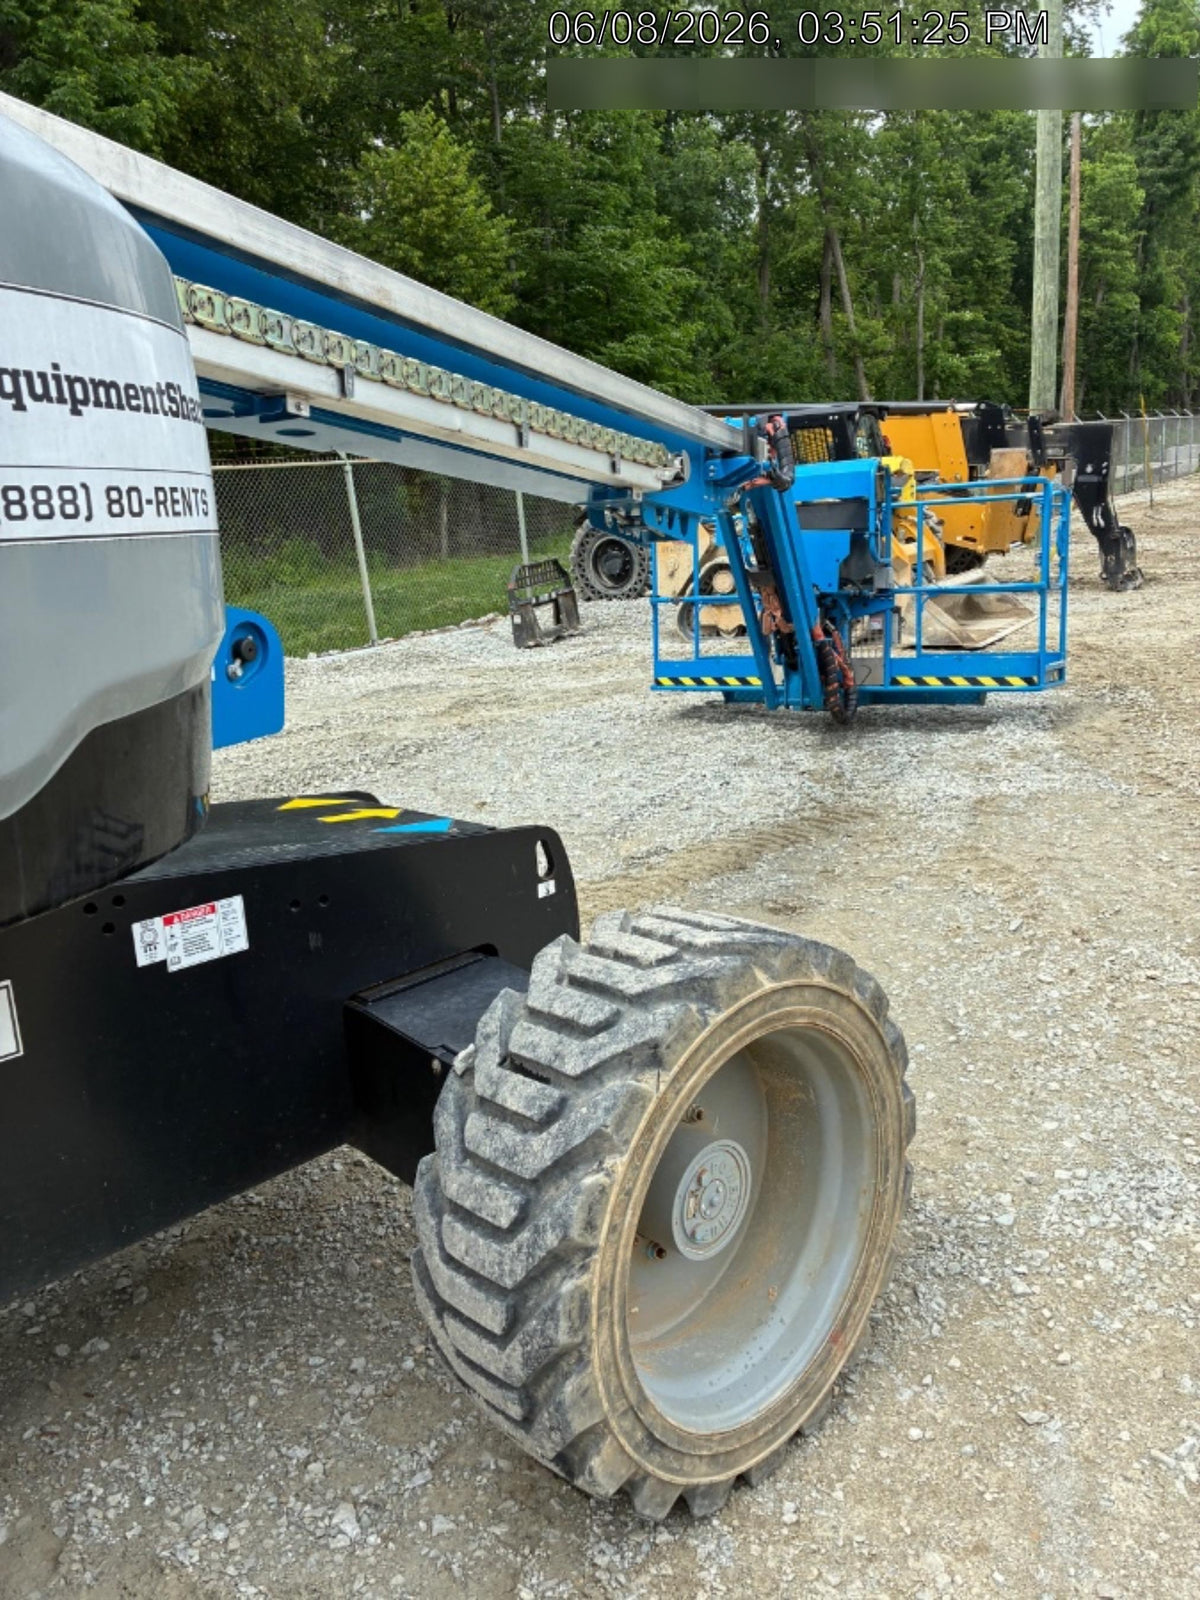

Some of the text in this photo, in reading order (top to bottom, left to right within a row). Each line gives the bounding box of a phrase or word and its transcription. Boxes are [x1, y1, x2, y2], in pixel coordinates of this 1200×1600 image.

[0, 362, 202, 424] quipmentSha
[0, 482, 209, 525] 888) 80-RENTS
